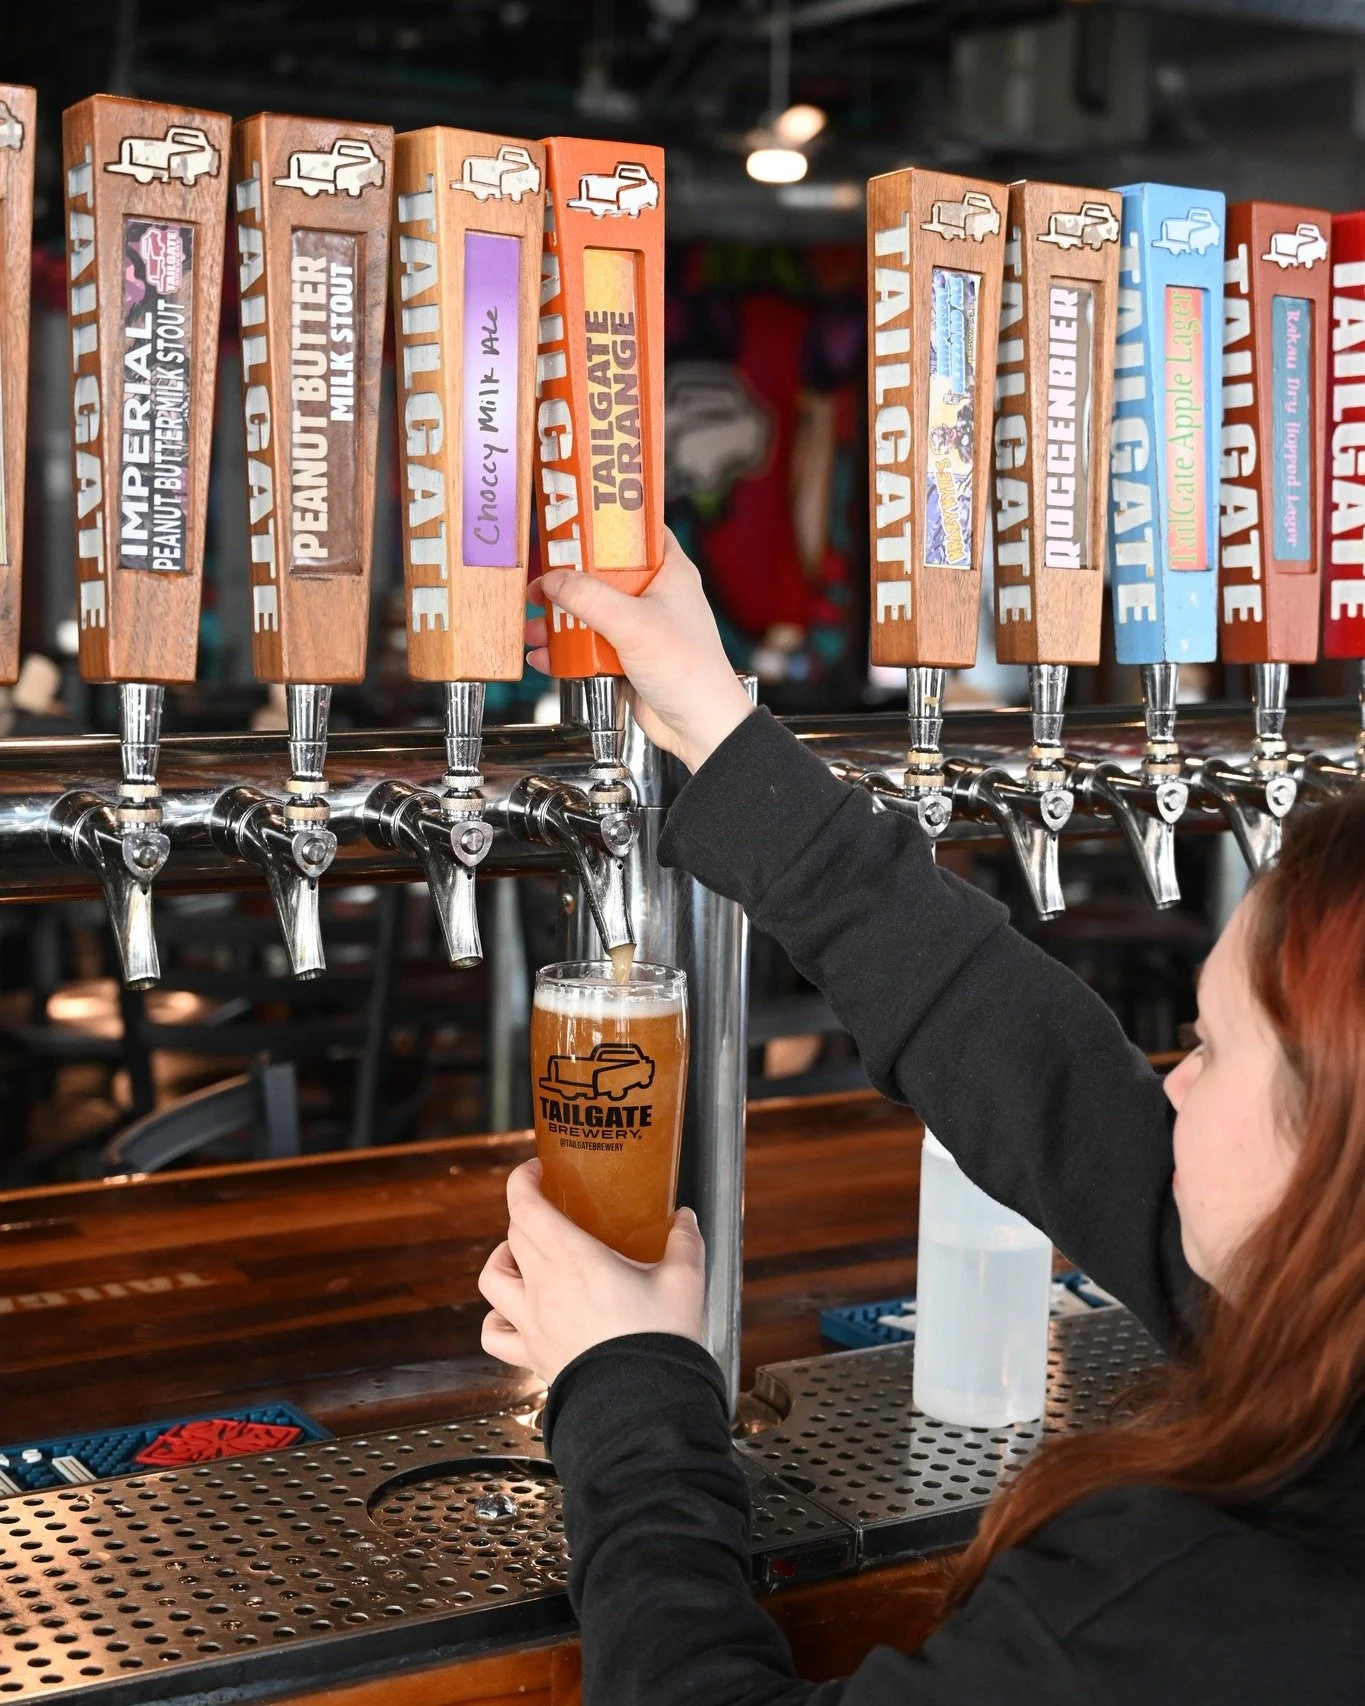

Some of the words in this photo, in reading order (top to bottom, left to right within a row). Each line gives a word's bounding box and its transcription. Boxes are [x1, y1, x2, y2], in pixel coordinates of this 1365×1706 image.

[166, 231, 177, 292] TAILGATE
[157, 299, 187, 363] STOUT
[291, 255, 329, 402] BUTTER
[330, 262, 354, 344] STOUT
[1165, 289, 1201, 364] Lager
[67, 143, 106, 631] TAILGATE
[155, 366, 185, 412] MILK
[235, 160, 279, 634] TAILGATE
[330, 347, 354, 422] MILK
[398, 173, 449, 634] TAILGATE
[477, 367, 500, 433] Milk
[585, 310, 619, 512] TAILGATE
[607, 311, 643, 512] ORANGE
[874, 211, 912, 624] TAILGATE
[1166, 373, 1202, 451] Apple
[1285, 377, 1300, 414] Dry
[121, 312, 153, 556] IMPERIAL
[153, 418, 184, 490] BUTTER
[1046, 288, 1081, 569] ROGGENBIER
[1111, 232, 1157, 624] TAILGATE
[1220, 243, 1263, 625] TAILGATE
[1284, 421, 1301, 486] Hopped
[291, 418, 329, 559] PEANUT
[473, 444, 509, 546] Choccy
[1167, 457, 1197, 566] TailGate
[1284, 495, 1301, 548] Lager
[153, 494, 182, 571] PEANUT
[540, 1097, 653, 1129] TAILGATE
[549, 1123, 641, 1140] BREWERY
[560, 1137, 624, 1151] @TAILGATEBREWERY
